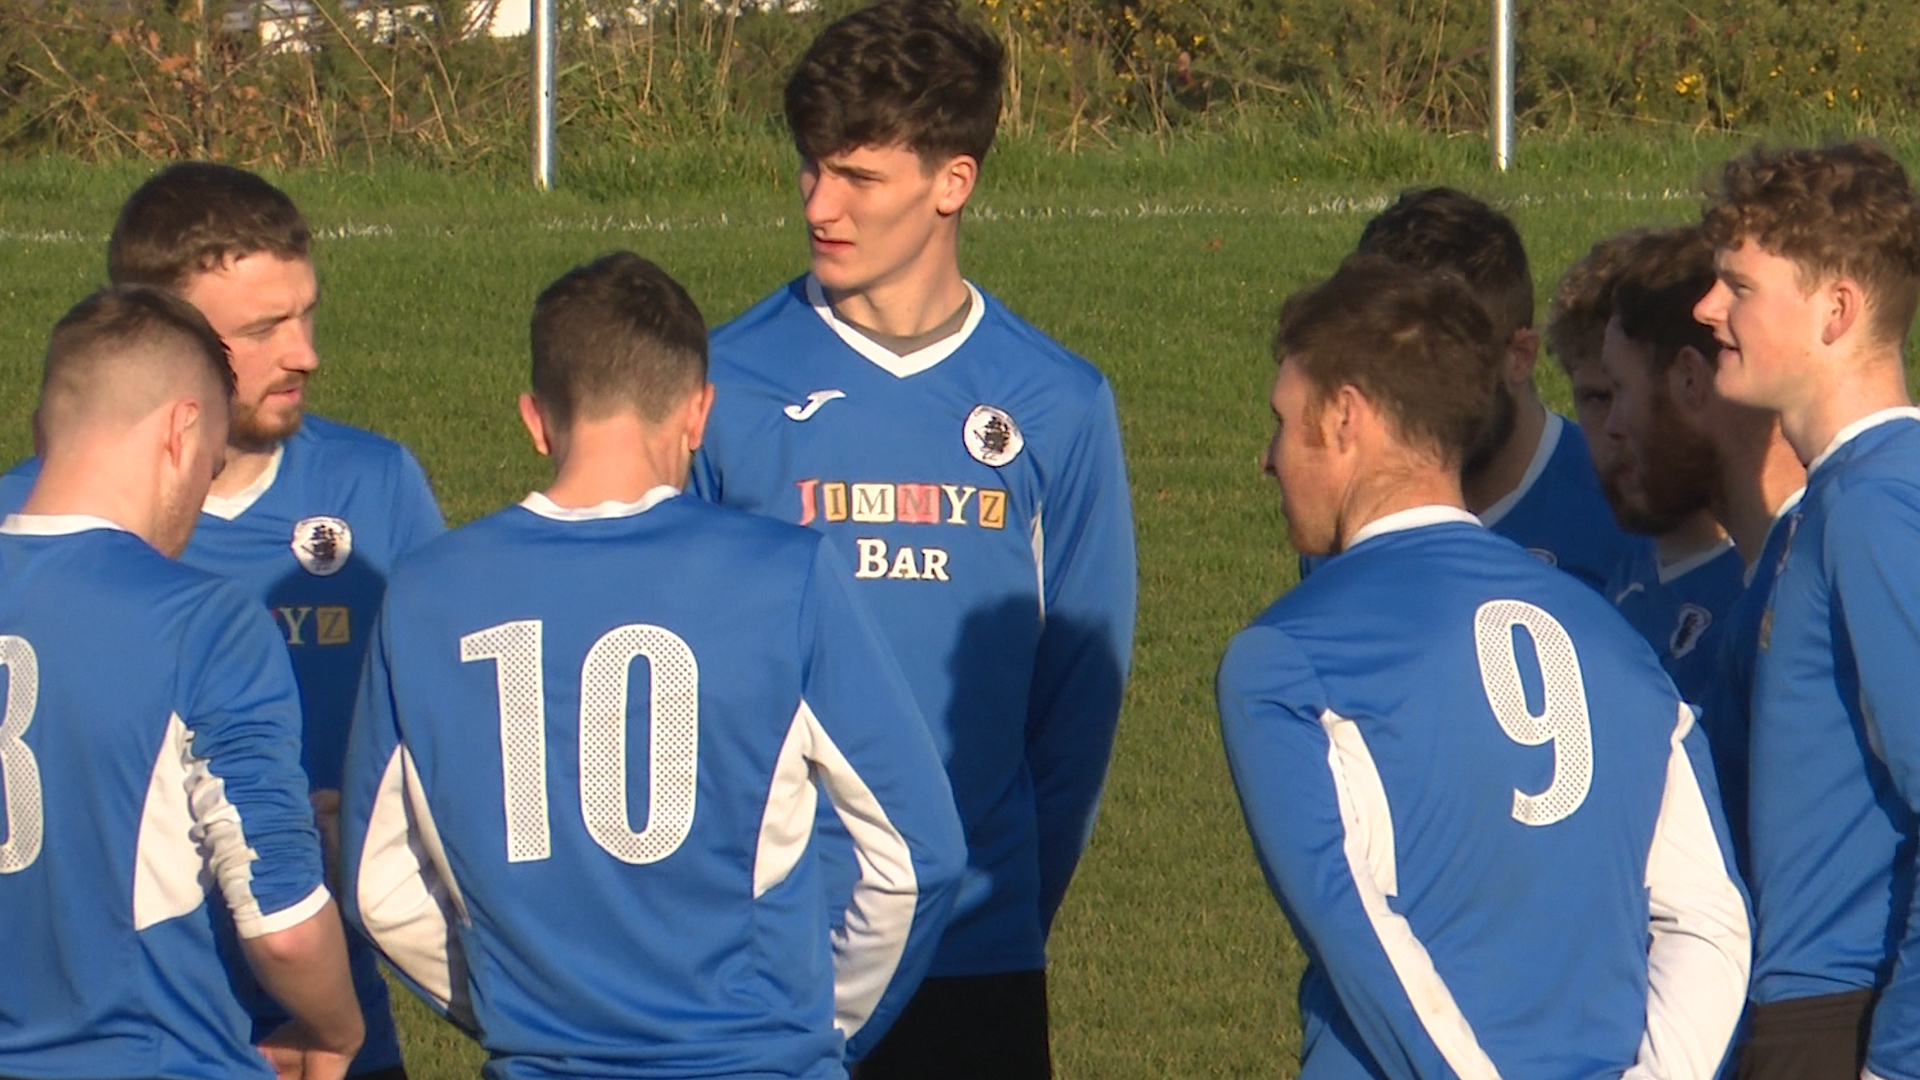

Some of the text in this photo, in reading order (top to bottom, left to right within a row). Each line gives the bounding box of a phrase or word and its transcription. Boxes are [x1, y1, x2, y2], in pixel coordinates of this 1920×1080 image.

[796, 479, 1007, 529] JIMMYZ
[854, 538, 950, 581] BAR
[460, 619, 699, 865] 10
[1474, 599, 1594, 827] 9
